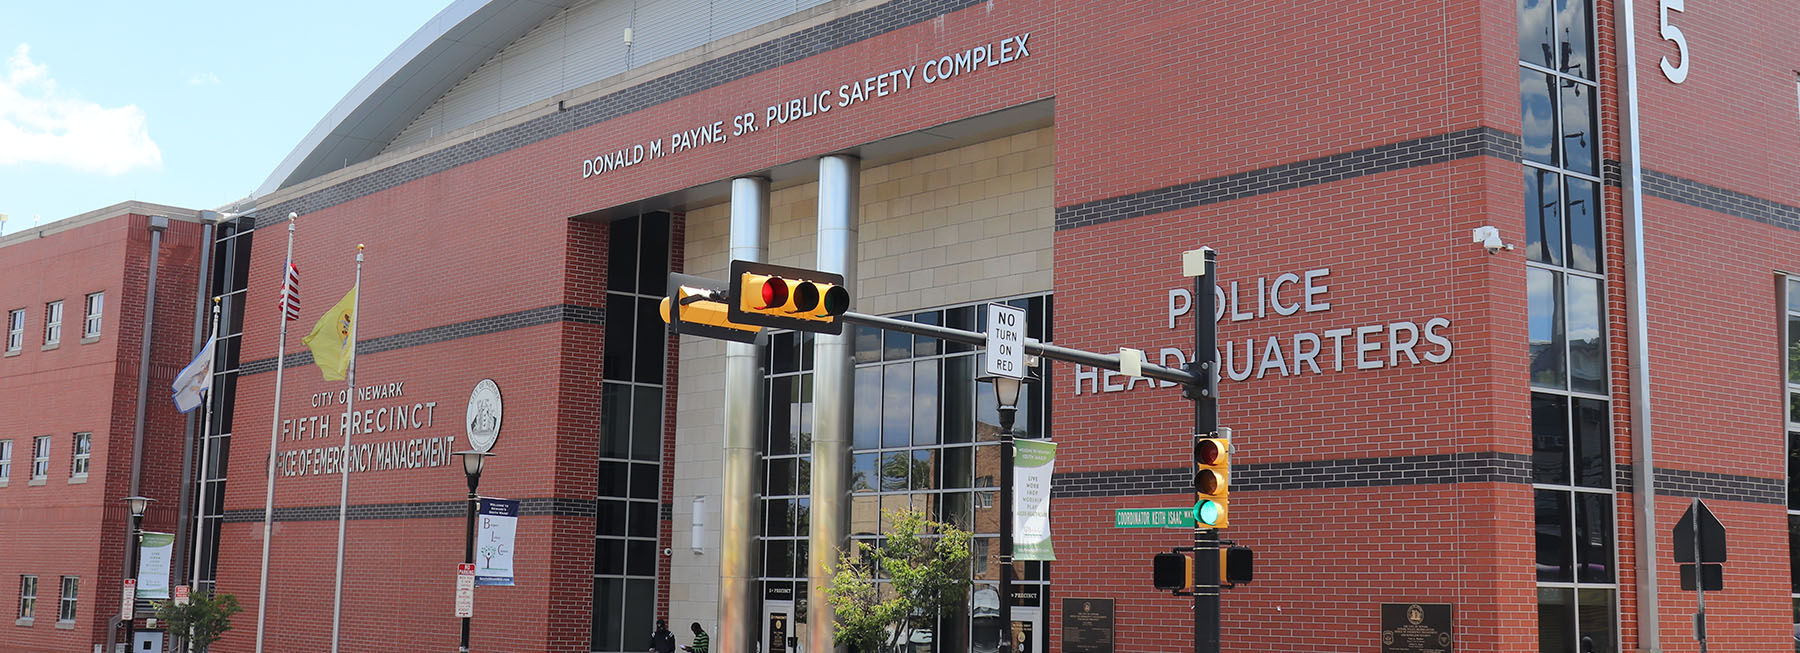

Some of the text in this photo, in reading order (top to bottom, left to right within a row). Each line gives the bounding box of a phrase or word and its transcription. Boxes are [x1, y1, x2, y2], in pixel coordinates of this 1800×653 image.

[1660, 0, 1690, 84] 5
[583, 33, 1030, 179] DONALD M. PAYNE, SR. PUBLIC SAFETY COMPLEX
[998, 311, 1015, 327] NO
[996, 327, 1017, 342] TURN
[999, 344, 1012, 356] ON
[996, 358, 1014, 372] RED
[312, 382, 404, 408] CITY O NEWARK
[282, 402, 437, 441] FIFTH PRECINCT
[267, 448, 298, 477] FICE
[298, 448, 313, 476] OF
[376, 436, 455, 471] MANAGEMENT
[1117, 511, 1150, 526] COORDINATOR
[1152, 511, 1166, 525] KEITH
[1167, 511, 1182, 525] ISAAC
